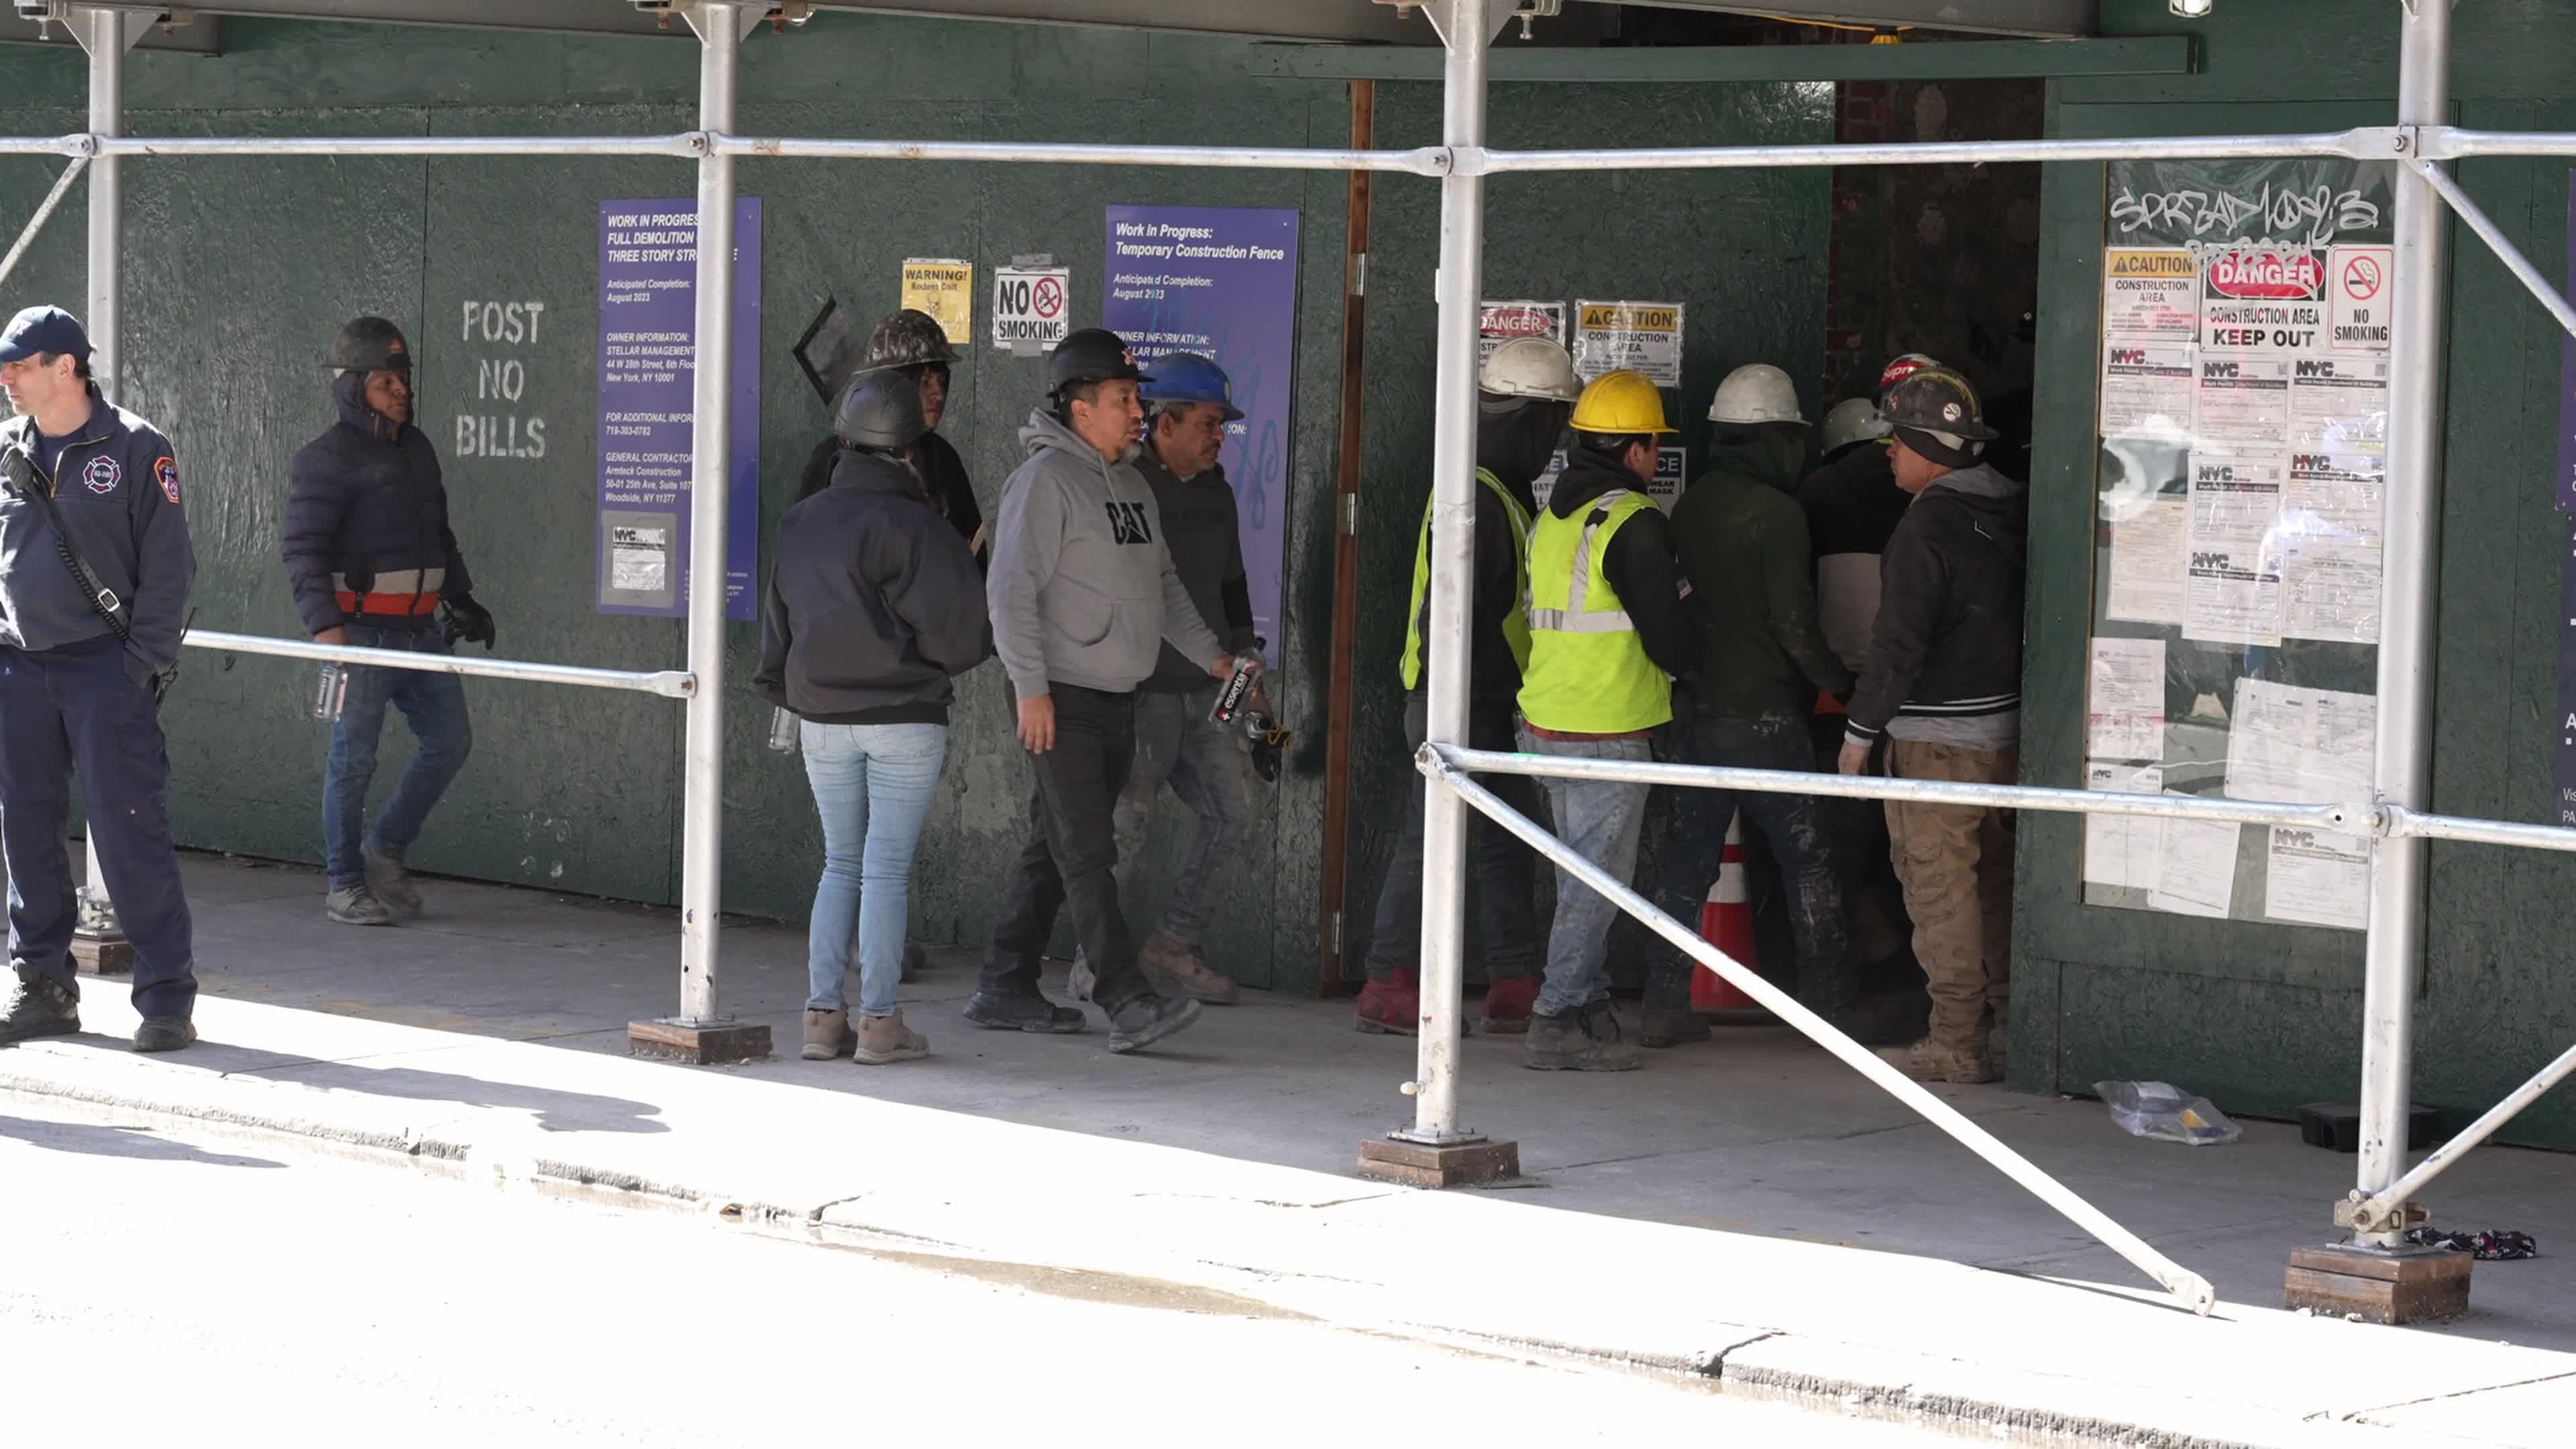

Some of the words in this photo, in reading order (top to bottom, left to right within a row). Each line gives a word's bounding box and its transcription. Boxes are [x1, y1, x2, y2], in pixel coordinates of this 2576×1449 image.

[607, 215, 638, 227] WORK
[639, 214, 650, 227] IN
[607, 232, 631, 245] FULL
[633, 231, 694, 244] DEMOLITION
[1116, 223, 1144, 236] Work
[1146, 225, 1157, 237] in
[1159, 224, 1213, 241] Progress:
[608, 250, 640, 262] THREE
[641, 249, 675, 262] STORY
[676, 249, 698, 261] STR
[1116, 241, 1173, 259] Temporary
[1176, 244, 1246, 259] Construction
[1249, 246, 1285, 260] Fence
[2129, 256, 2193, 272] CAUTION
[906, 269, 967, 281] WARNING!
[1163, 275, 1213, 288] Completion:
[2218, 264, 2314, 285] DANGER
[607, 278, 647, 290] Anticipated
[2115, 280, 2189, 290] CONSTRUCTION
[607, 293, 633, 304] August
[999, 280, 1030, 315] NO
[1112, 288, 1143, 301] August
[2139, 292, 2165, 302] AREA
[463, 301, 544, 345] POST
[2210, 307, 2289, 325] CONSTRUCTION
[2292, 308, 2320, 325] AREA
[2353, 309, 2369, 323] NO
[606, 333, 634, 342] OWNER
[1588, 331, 1668, 343] CONTRUCTION
[2214, 328, 2266, 346] KEEP
[2273, 329, 2315, 347] OUT
[2334, 325, 2387, 341] SMOKING
[606, 345, 640, 355] STELLAR
[641, 345, 696, 356] MANAGEMENT
[2111, 350, 2146, 364] NYC
[679, 360, 696, 369] Floo
[2204, 363, 2239, 378] NYC
[2296, 360, 2334, 377] NYC
[478, 359, 524, 402] NO
[606, 413, 623, 421] FOR
[456, 415, 545, 458] BILLS
[606, 452, 641, 462] GENERAL
[2293, 455, 2330, 470] NYC
[2199, 467, 2233, 480] NYC
[1106, 502, 1152, 545] CAT
[614, 529, 637, 541] NYC
